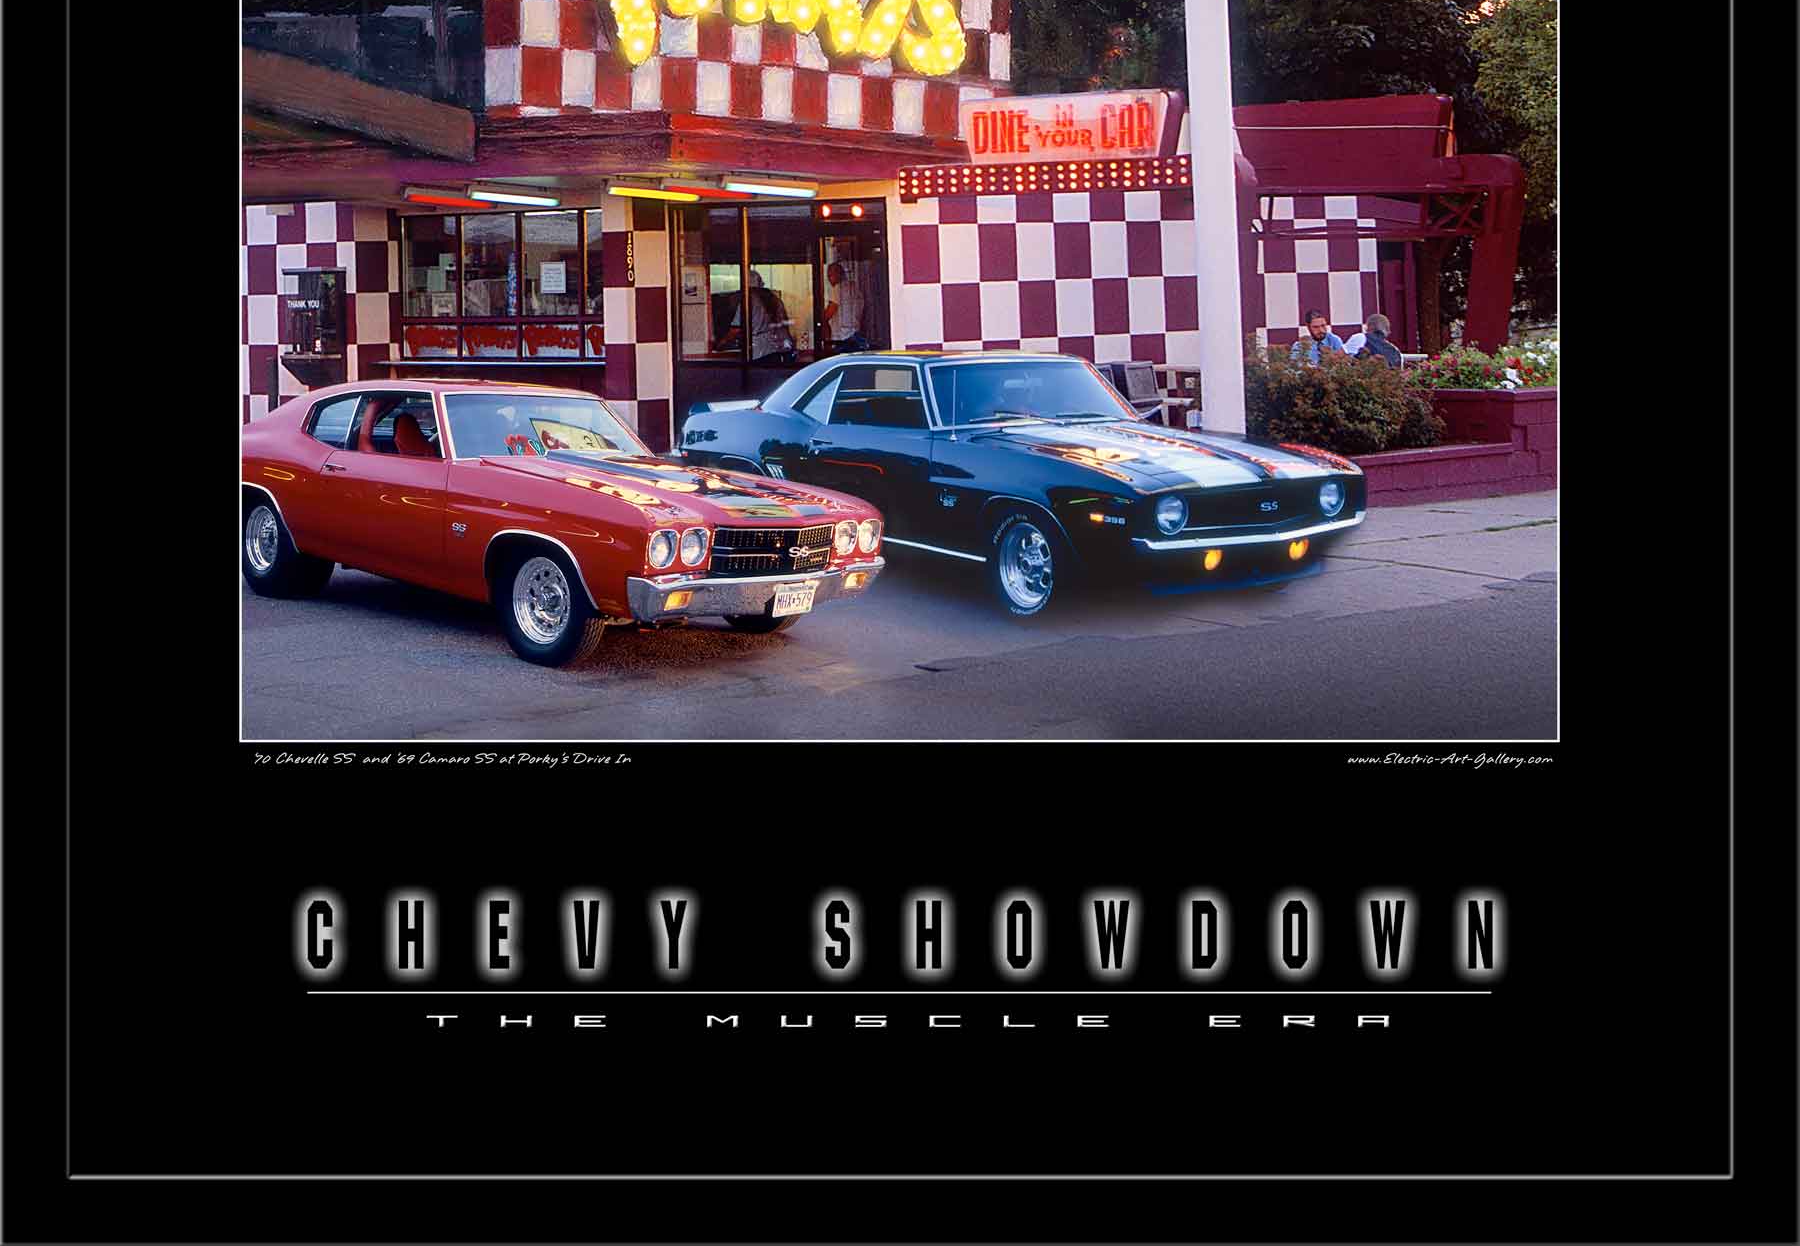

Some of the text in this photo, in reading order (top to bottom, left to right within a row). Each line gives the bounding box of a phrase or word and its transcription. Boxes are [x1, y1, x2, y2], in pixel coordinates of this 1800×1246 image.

[972, 110, 1030, 154] DINE
[1037, 126, 1094, 152] YOUR
[1100, 101, 1156, 150] CAR
[626, 232, 634, 282] 1890
[287, 299, 320, 308] THANK YOU
[1260, 501, 1279, 512] SS
[452, 522, 467, 532] SS
[789, 545, 808, 557] SS
